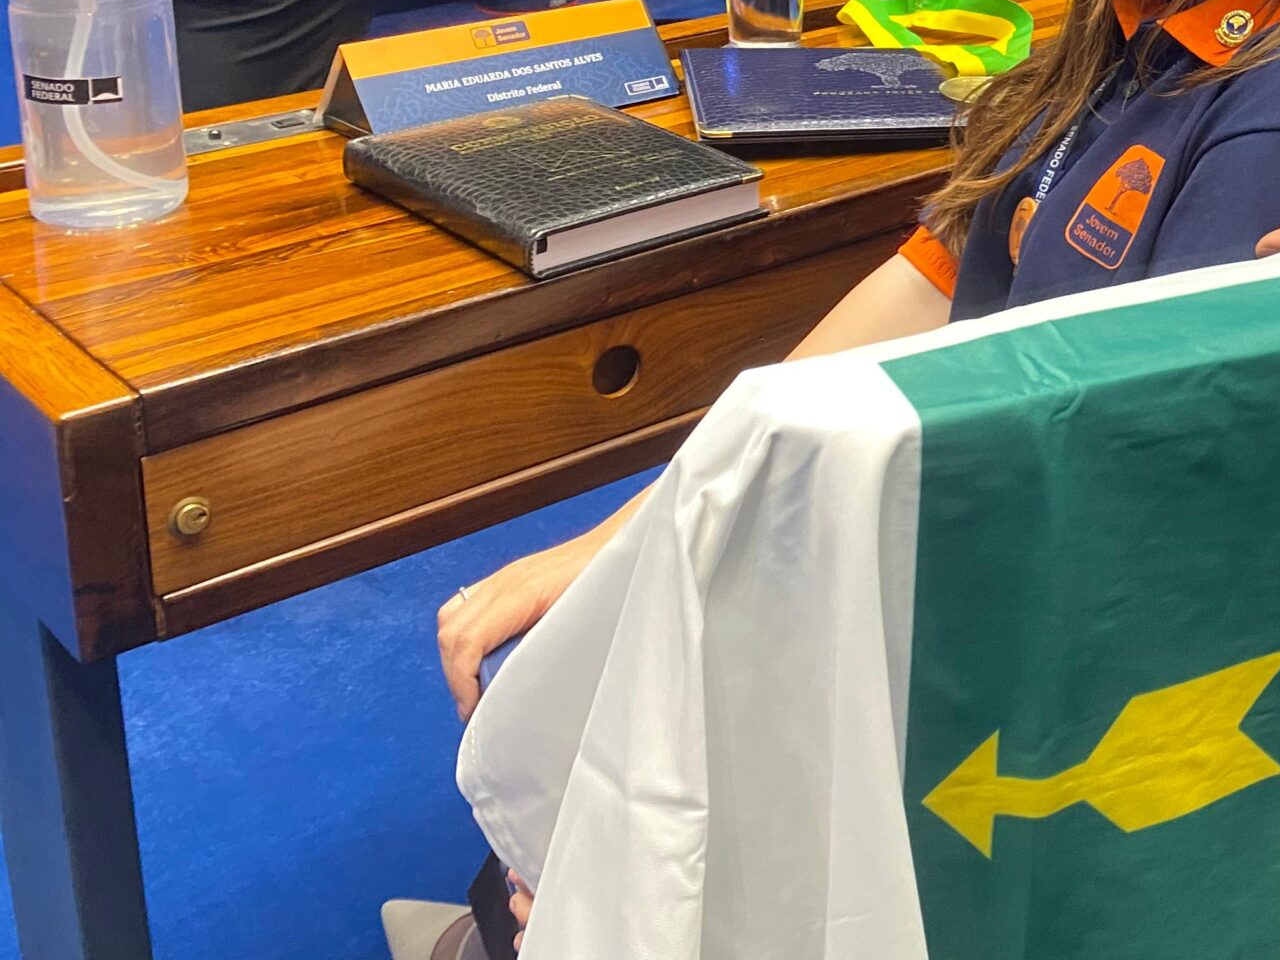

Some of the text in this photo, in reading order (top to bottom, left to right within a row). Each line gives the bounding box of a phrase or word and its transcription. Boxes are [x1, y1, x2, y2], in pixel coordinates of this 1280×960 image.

[425, 52, 604, 93] MARIA EDUARDA DOS SANTOS ALVES
[31, 81, 75, 93] SENADO
[31, 90, 76, 102] FEDERAL
[487, 80, 562, 103] Distrito Federal
[1050, 125, 1078, 168] SENADO
[1073, 223, 1116, 258] Senador
[1086, 214, 1119, 241] Jovem
